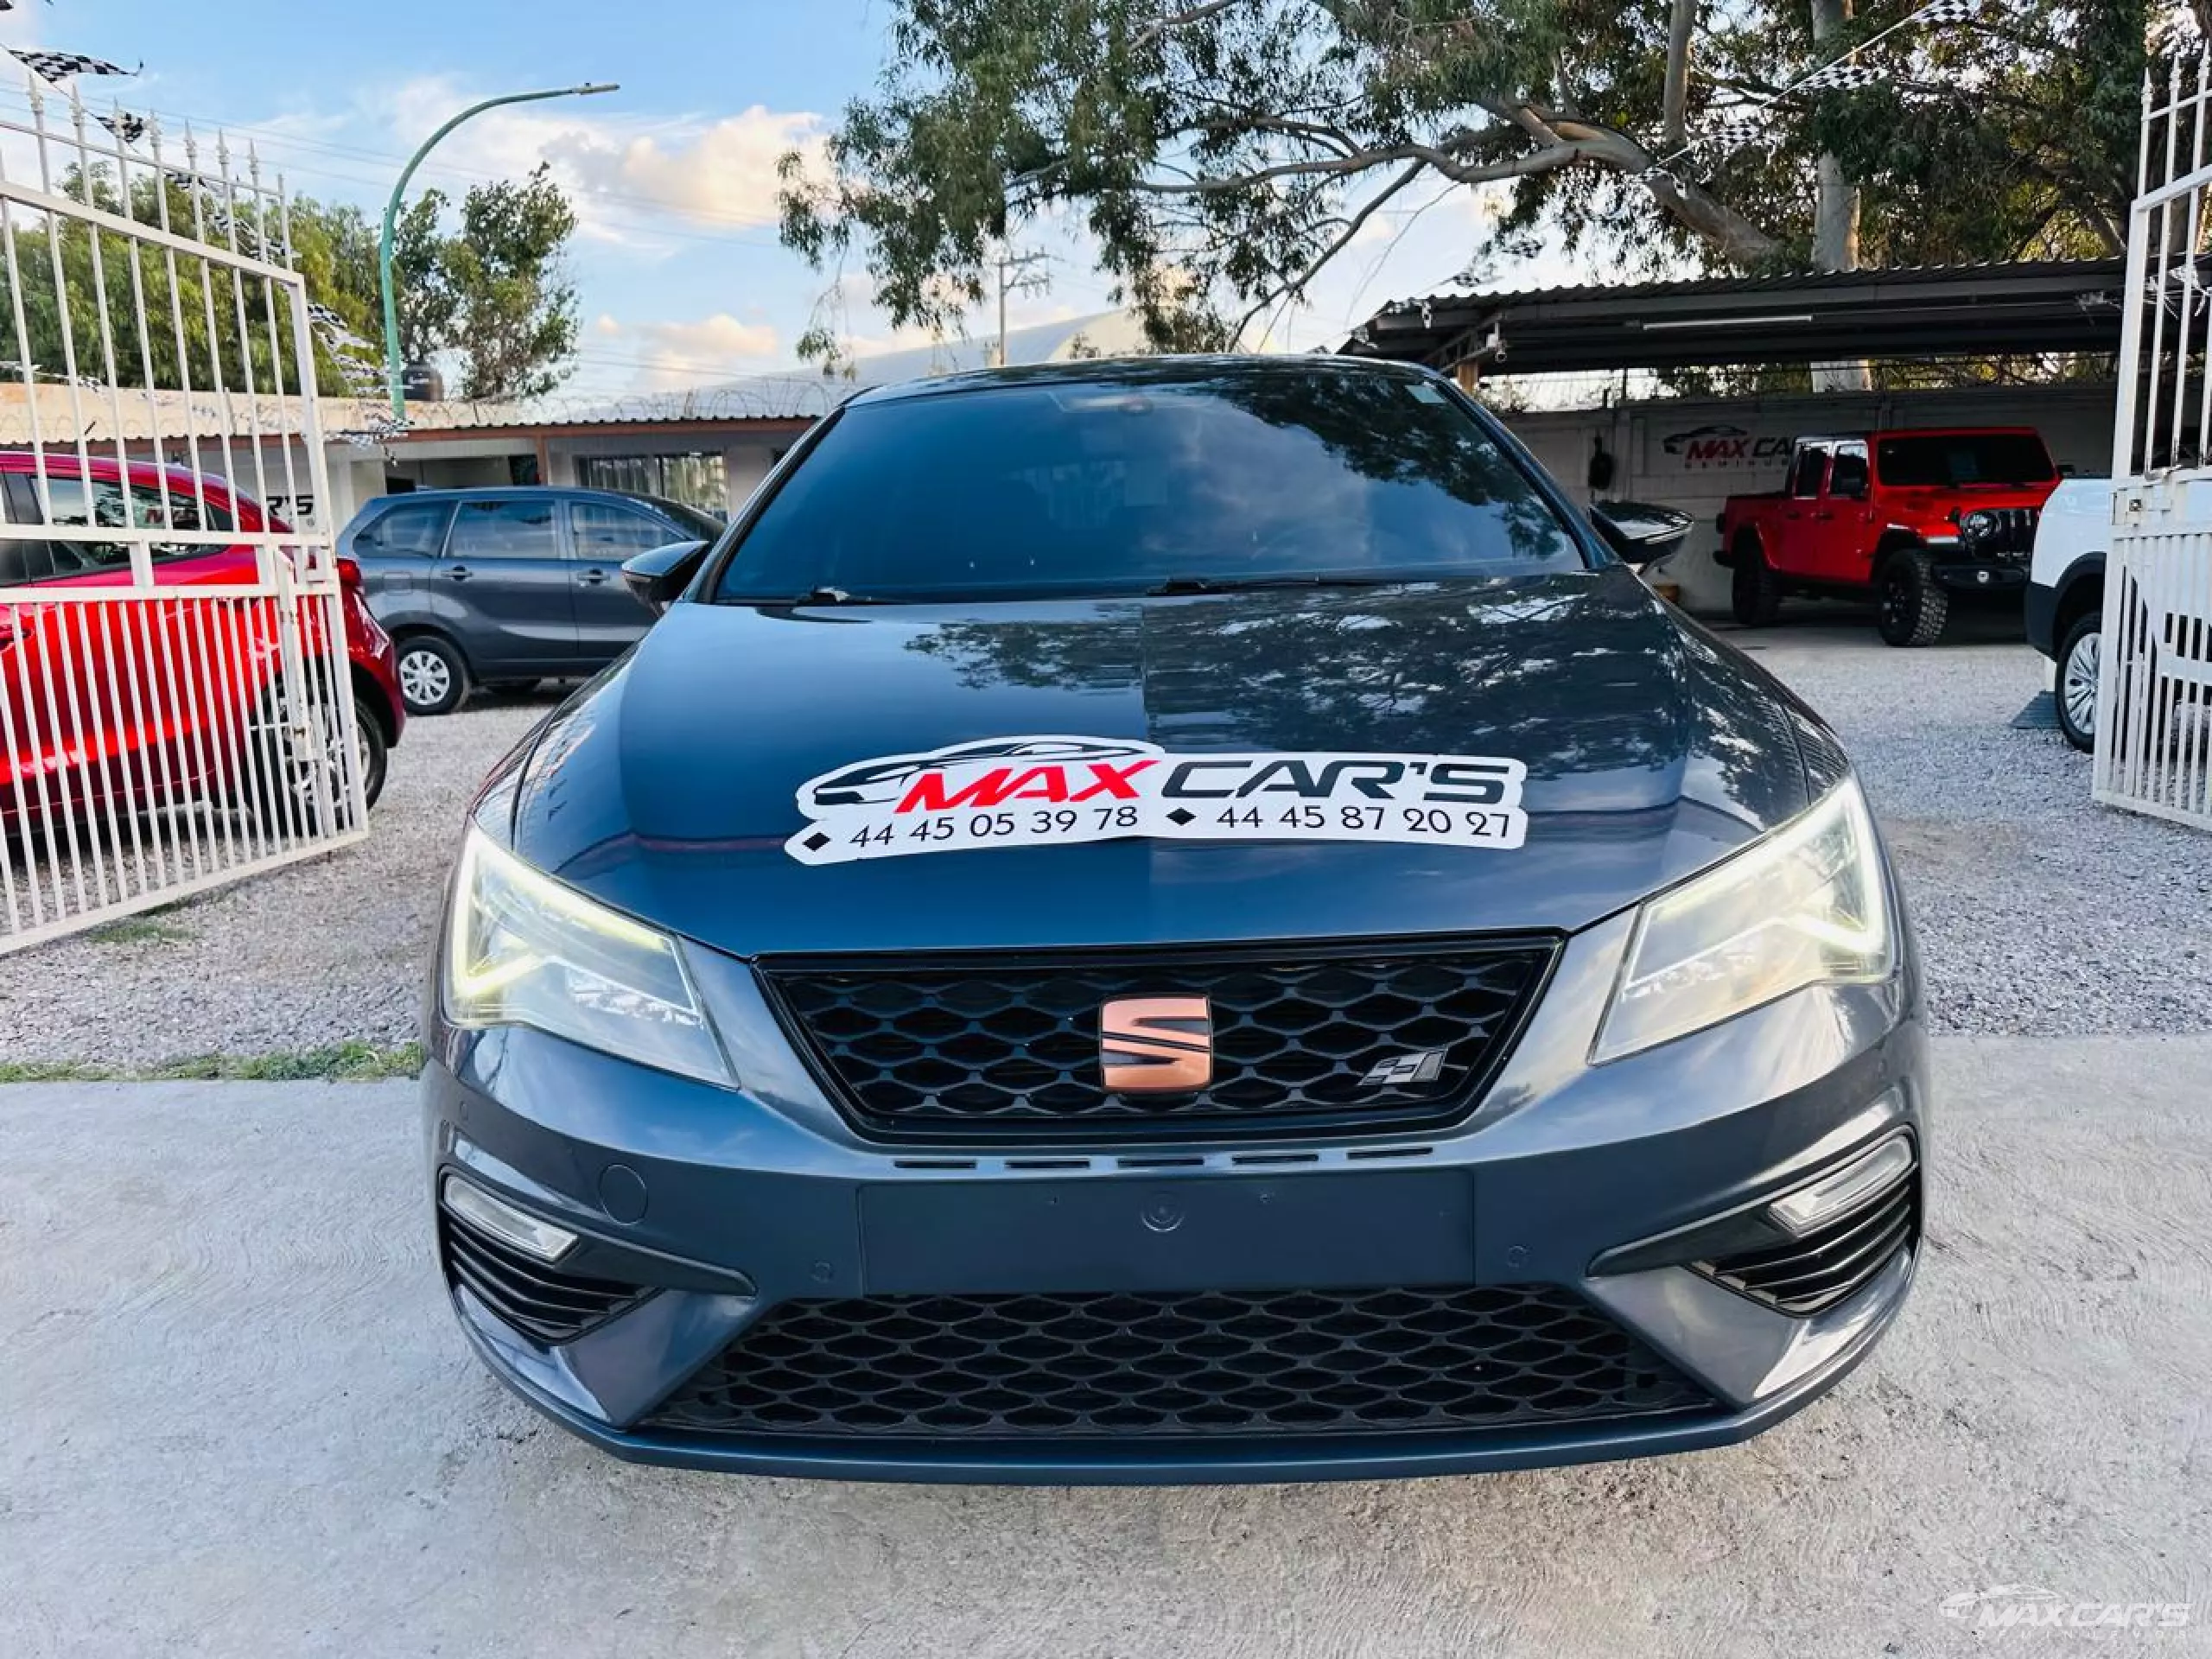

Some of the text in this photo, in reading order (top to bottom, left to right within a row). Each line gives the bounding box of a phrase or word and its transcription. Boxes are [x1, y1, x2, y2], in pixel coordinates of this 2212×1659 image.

[1687, 437, 1791, 460] MAX CA
[894, 760, 1510, 814] MAX CAR'S
[849, 805, 1510, 848] 44 45 05 39 78 44 45 87 20 27
